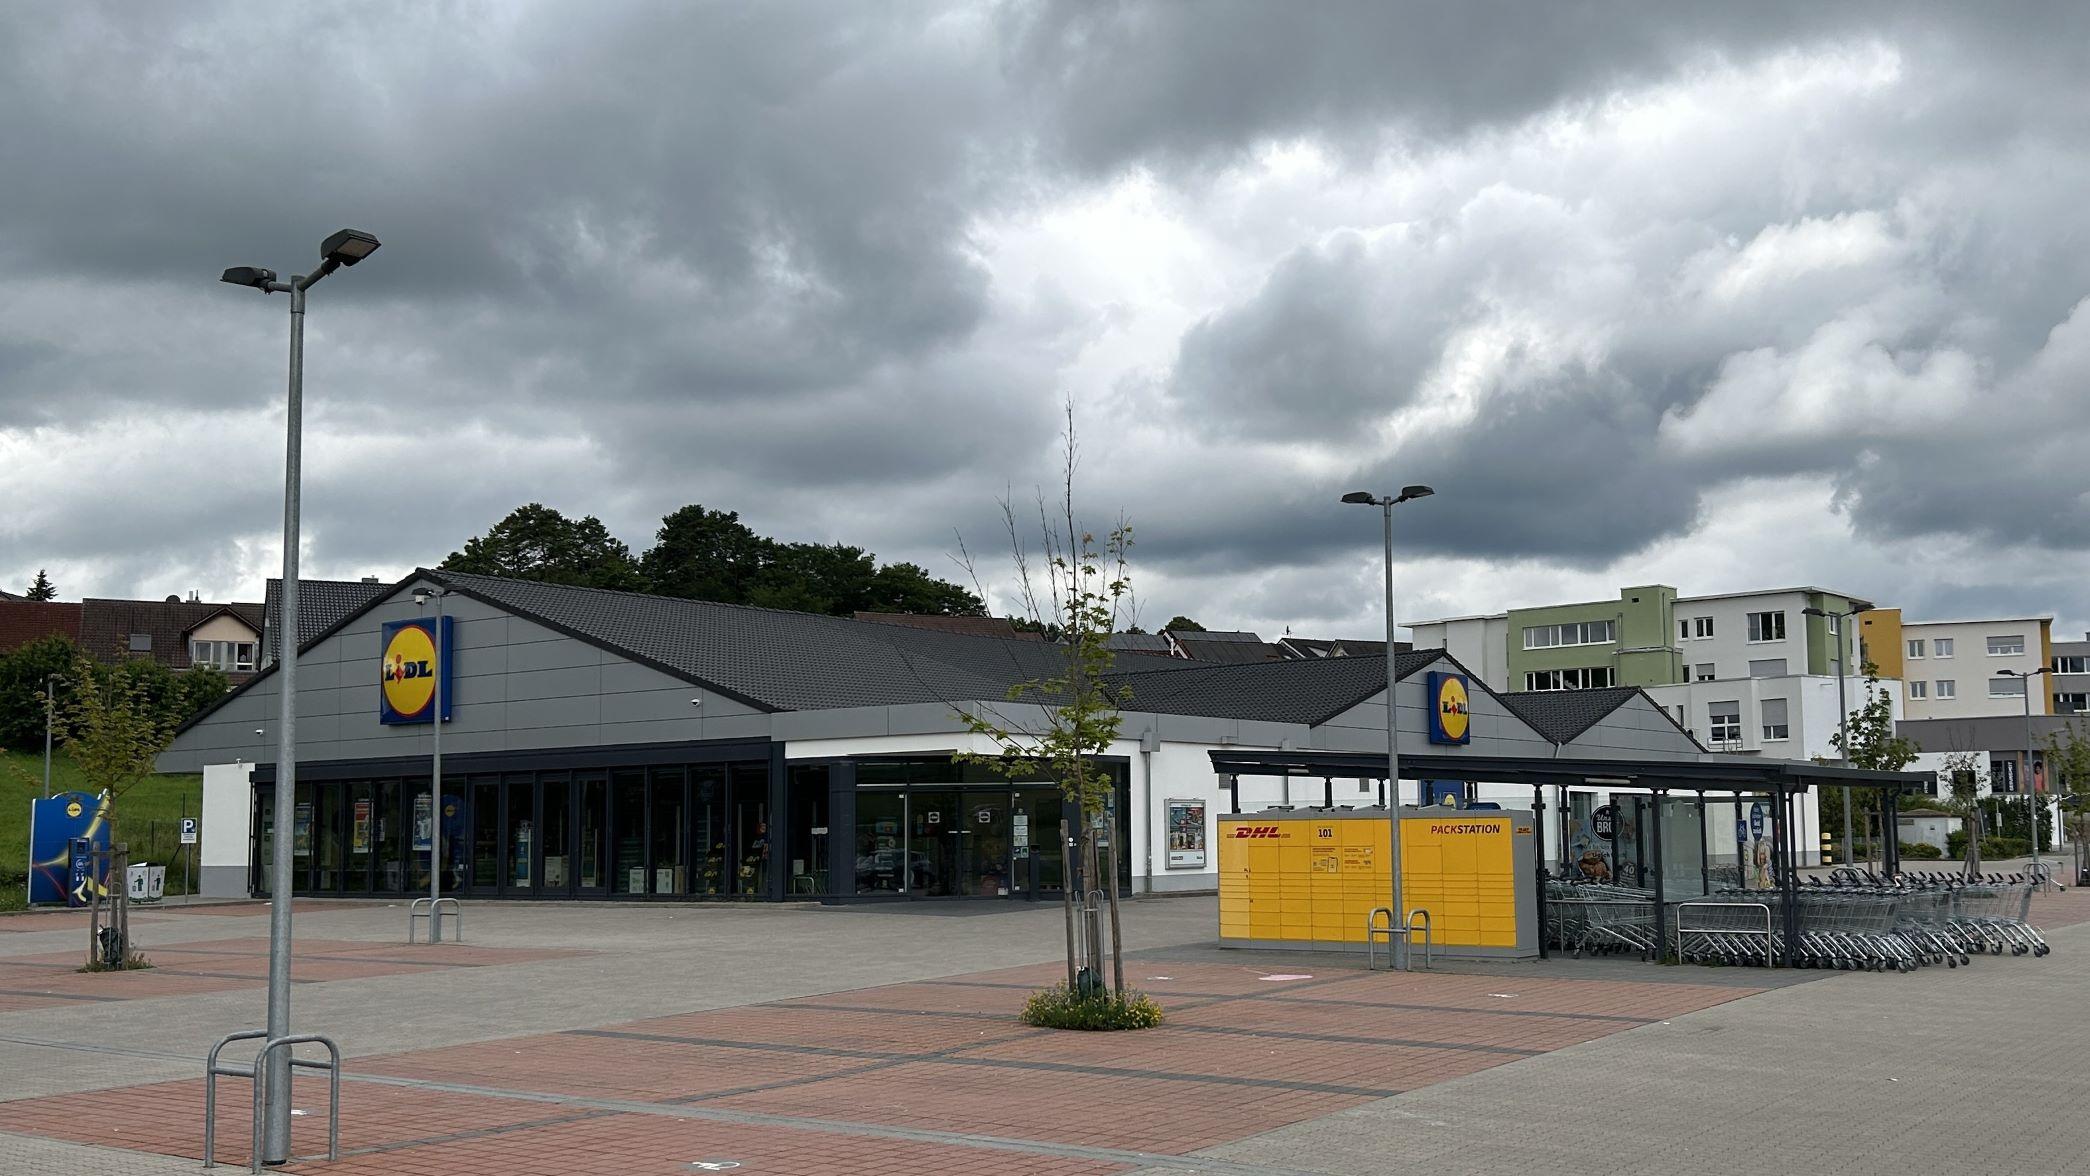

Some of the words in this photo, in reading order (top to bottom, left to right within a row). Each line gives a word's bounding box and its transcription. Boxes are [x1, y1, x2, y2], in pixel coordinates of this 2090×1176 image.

[1235, 826, 1281, 838] DHL
[1318, 829, 1332, 838] 101
[1430, 824, 1501, 835] PACKSTATION
